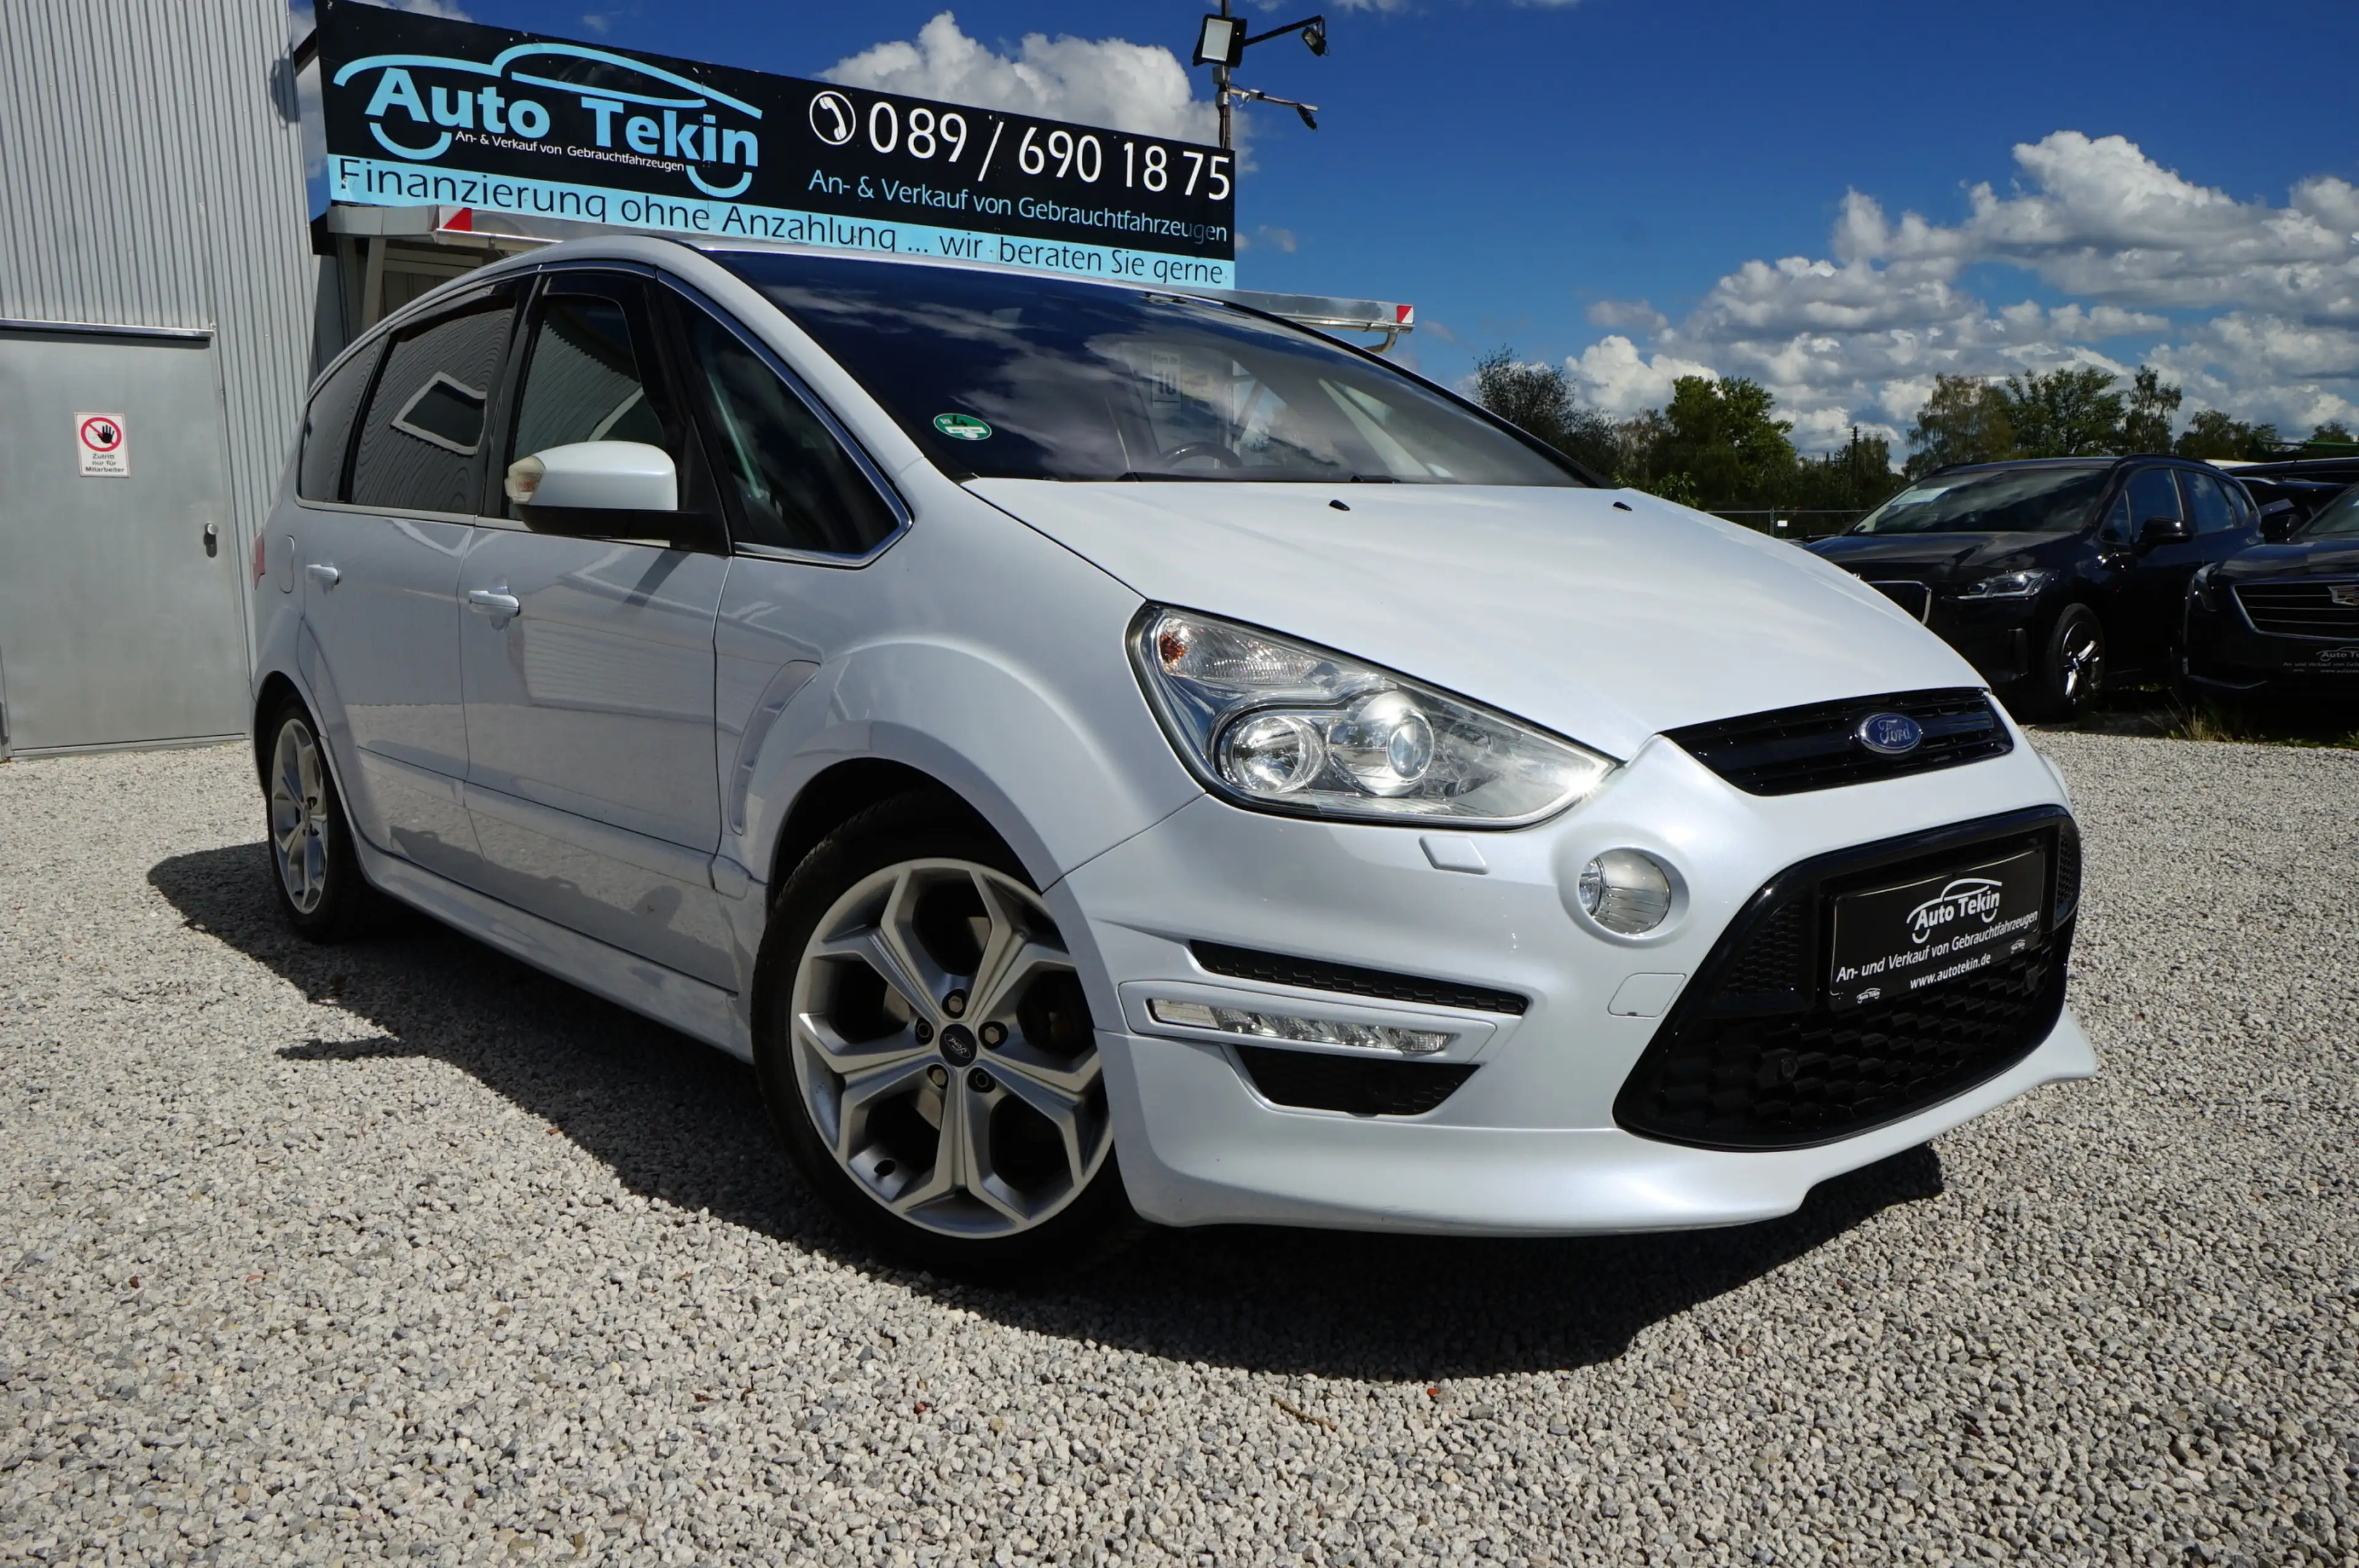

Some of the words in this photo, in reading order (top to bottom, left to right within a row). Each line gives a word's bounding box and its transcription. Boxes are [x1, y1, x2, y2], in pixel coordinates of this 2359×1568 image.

[364, 68, 550, 139] Auto
[581, 96, 758, 166] Tekin
[455, 131, 477, 142] An-
[480, 134, 490, 145] &
[491, 136, 539, 152] Verkauf
[539, 143, 561, 155] von
[567, 146, 684, 172] Gebrauchtfahrzeugen
[869, 102, 967, 162] 089
[978, 121, 1004, 182] /
[1019, 127, 1101, 182] 690
[1124, 142, 1167, 192] 18
[1183, 151, 1229, 200] 75
[340, 158, 606, 223] Finanzierung
[621, 195, 709, 230] ohne
[722, 206, 896, 252] Anzahlung
[939, 232, 984, 258] wir
[1000, 236, 1101, 271] beraten
[1111, 249, 1144, 276] Sie
[1154, 260, 1223, 284] gerne
[808, 170, 850, 194] An-
[857, 176, 874, 198] &
[882, 178, 969, 210] Verkauf
[973, 195, 1011, 215] von
[1019, 197, 1227, 244] Gebrauchtfahrzeugen
[1878, 719, 1912, 744] Ford
[1914, 905, 1955, 930] Auto
[1958, 891, 2000, 917] Tekin
[1836, 967, 1858, 983] An-
[1861, 957, 1886, 977] und
[1888, 945, 1930, 970] Verkauf
[1931, 942, 1949, 958] von
[1952, 911, 2038, 951] Gebrauchtfahrzeugen
[1910, 953, 1991, 989] www.autotekin.de
